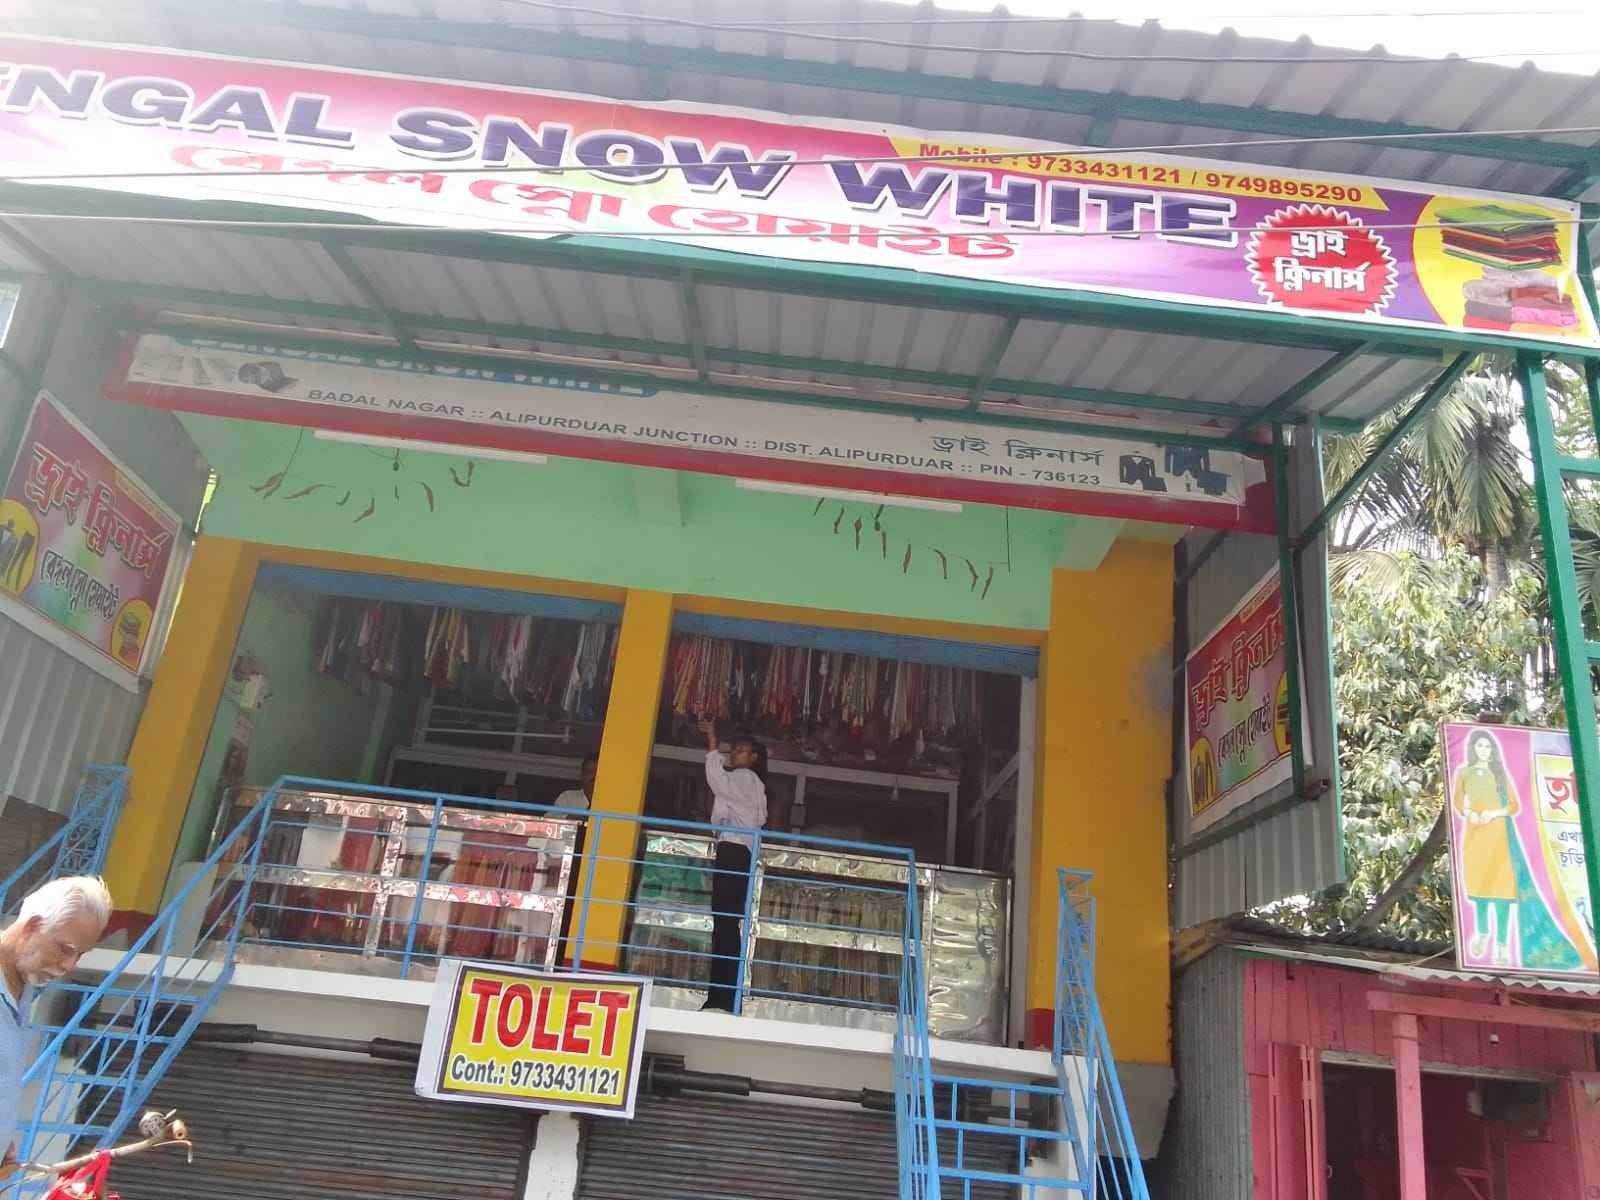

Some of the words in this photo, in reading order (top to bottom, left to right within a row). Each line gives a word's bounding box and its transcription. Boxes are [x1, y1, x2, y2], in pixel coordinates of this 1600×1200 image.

[0, 65, 353, 147] NGAL
[391, 108, 794, 197] SNOW
[827, 157, 1238, 248] WHITE
[919, 143, 1002, 164] Mobile
[1027, 154, 1181, 184] 9733431121
[1206, 173, 1362, 202] 9749895290
[1290, 230, 1349, 258] ড্রাই
[1272, 256, 1371, 292] ক্লিনার্স
[308, 389, 378, 409] BADAL
[388, 399, 465, 418] NAGAR
[490, 410, 627, 435] ALIPURDUAR
[633, 425, 738, 449] JUNCTION
[764, 439, 813, 456] DIST.
[819, 446, 953, 472] ALIPURDUAR
[980, 462, 1014, 477] PIN
[1032, 468, 1101, 485] 736123
[931, 435, 991, 456] ড্রাই
[471, 978, 630, 1057] TOLET
[511, 1060, 620, 1096] 9733431121
